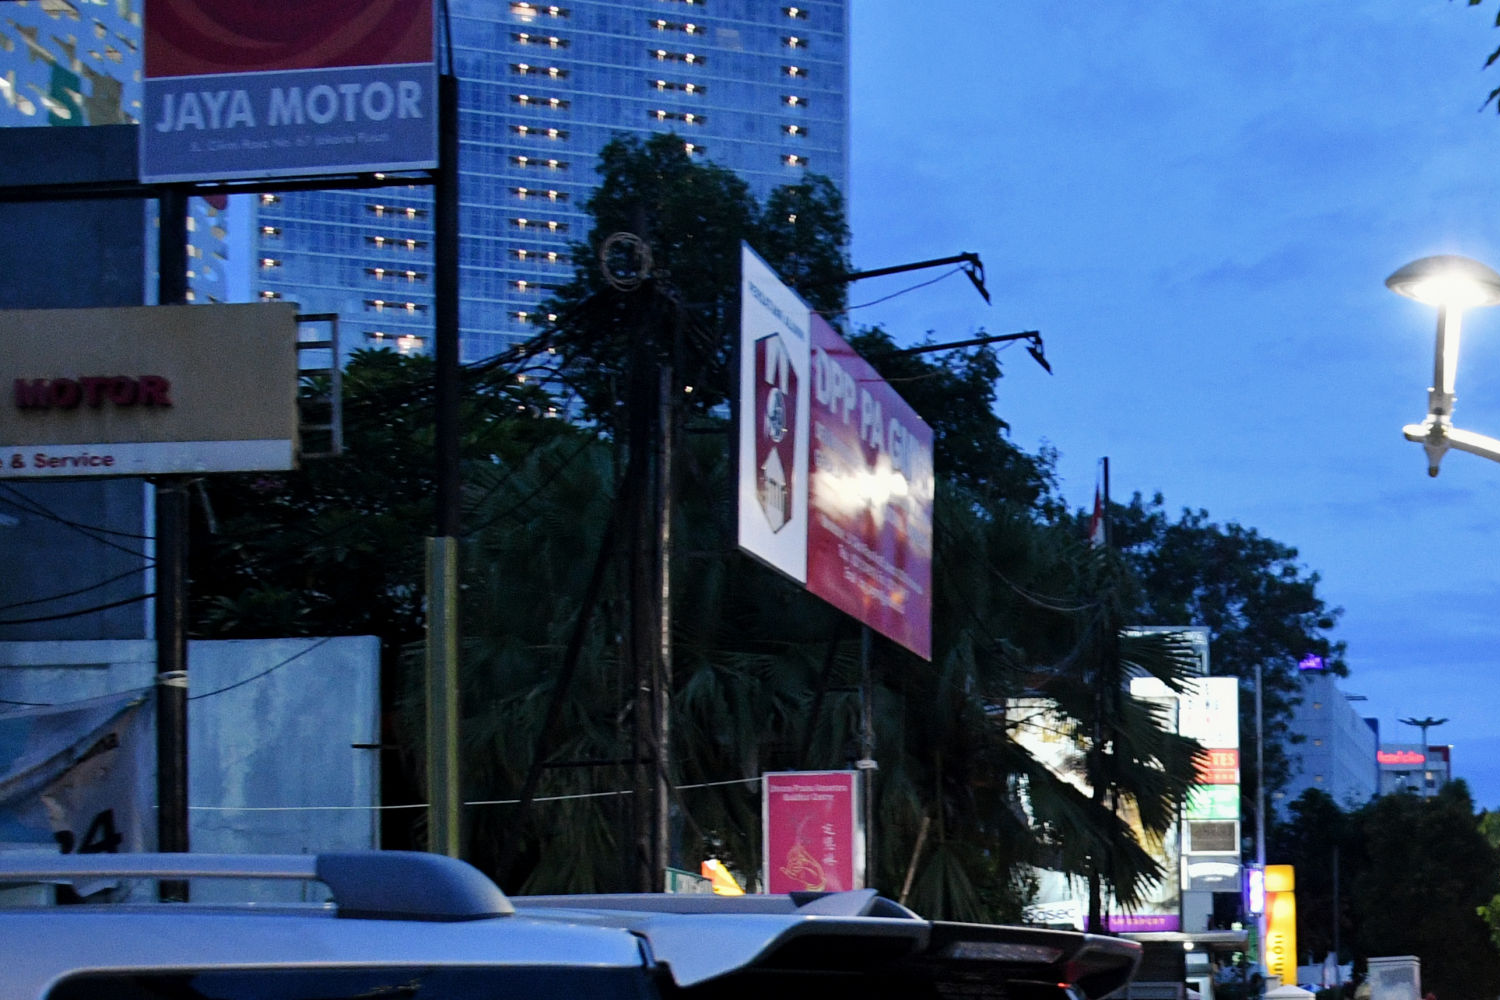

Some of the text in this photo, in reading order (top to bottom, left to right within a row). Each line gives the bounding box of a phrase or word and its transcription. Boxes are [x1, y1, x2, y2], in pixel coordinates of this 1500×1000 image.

[155, 80, 424, 133] JAYA MOTOR
[13, 375, 174, 409] MOTOR
[11, 452, 116, 469] & Service
